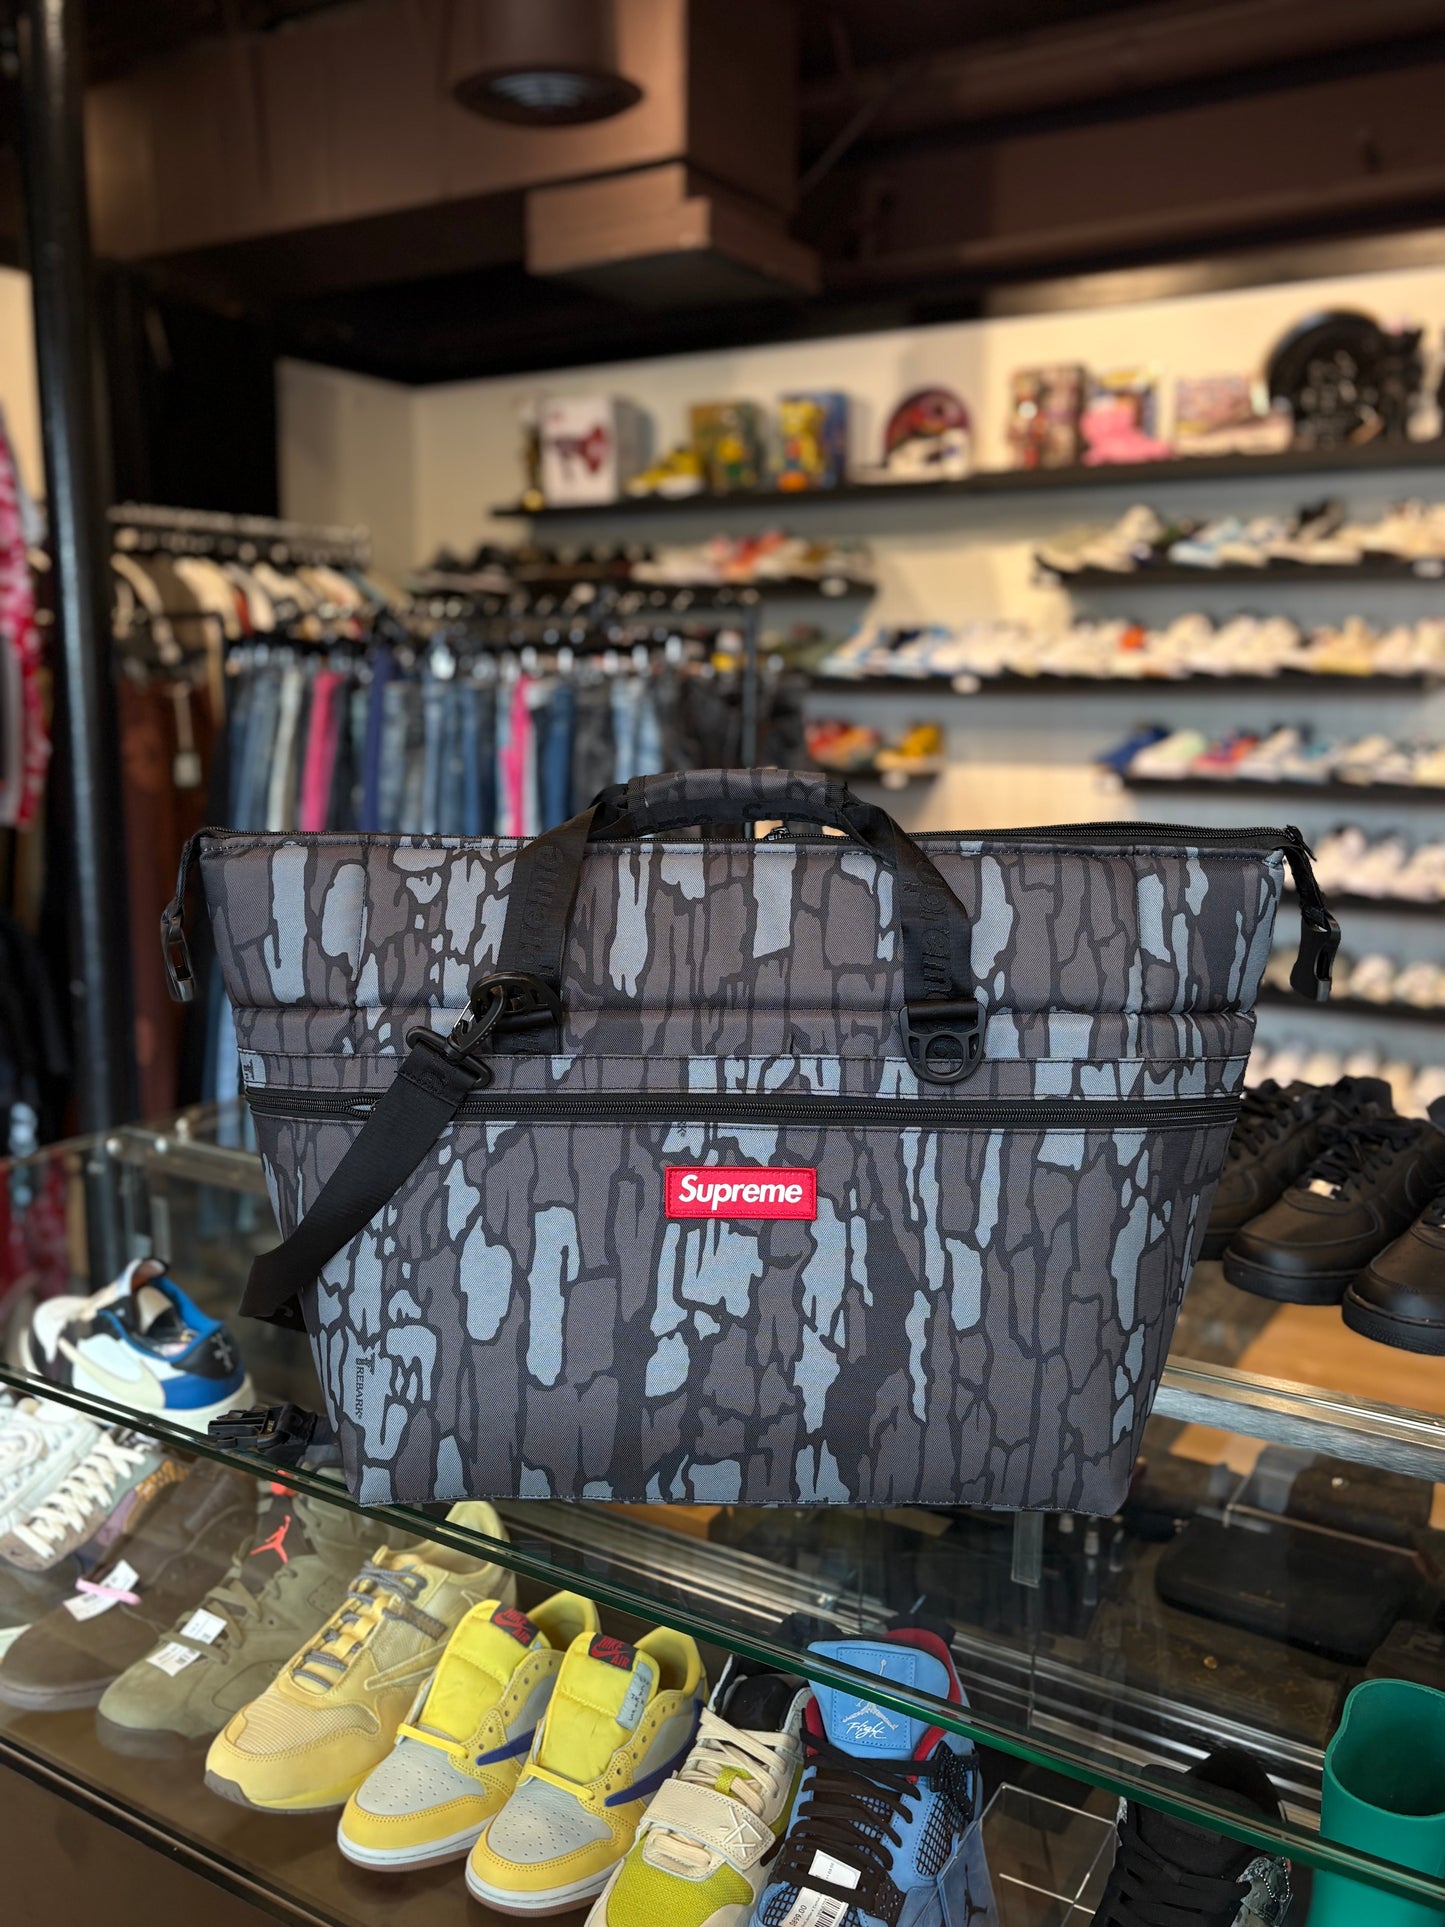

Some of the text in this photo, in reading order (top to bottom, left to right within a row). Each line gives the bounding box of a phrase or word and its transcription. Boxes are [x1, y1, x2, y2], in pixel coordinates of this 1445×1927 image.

[678, 1174, 803, 1211] Supreme
[512, 1627, 533, 1645] AIR
[599, 1636, 625, 1650] NIKE
[611, 1655, 630, 1668] AIR
[845, 1720, 887, 1739] Flight
